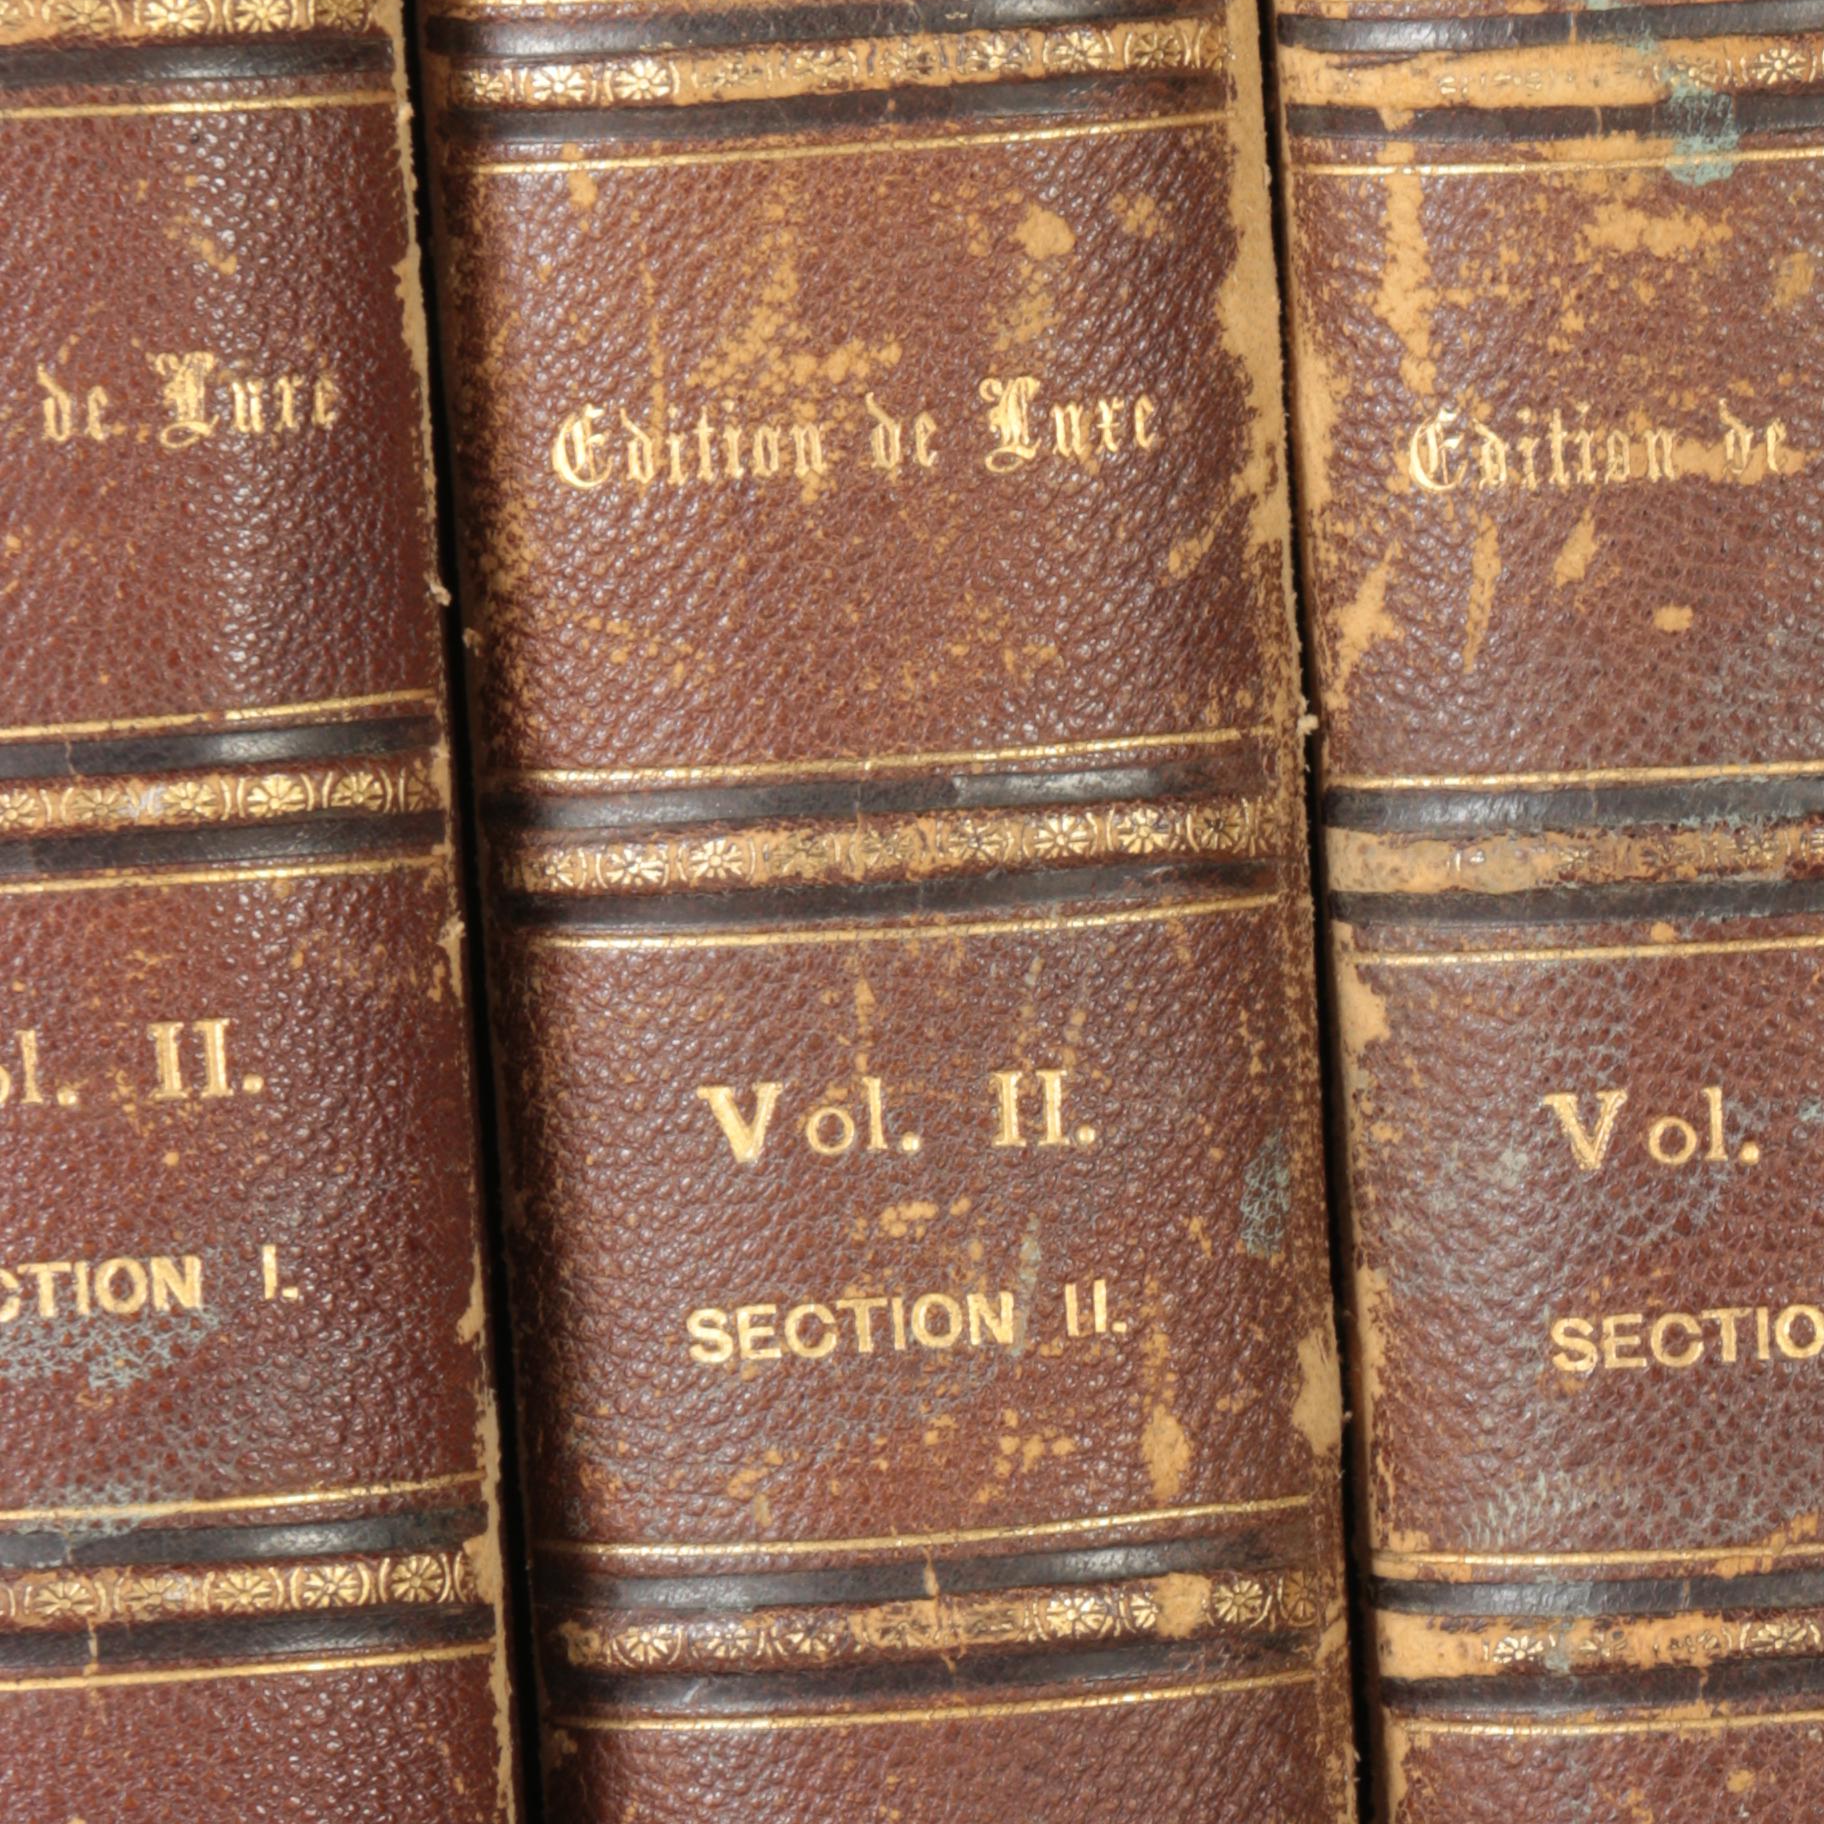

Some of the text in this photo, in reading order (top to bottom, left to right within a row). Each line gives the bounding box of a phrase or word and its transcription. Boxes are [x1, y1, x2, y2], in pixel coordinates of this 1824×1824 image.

[37, 351, 340, 448] de Luxe
[551, 376, 1167, 488] Edition de Luxe
[1409, 399, 1680, 492] Edition
[1718, 398, 1788, 474] de
[147, 1017, 264, 1100] II.
[697, 1070, 1097, 1163] Vol. II.
[1543, 1086, 1760, 1170] Vol.
[262, 1244, 299, 1300] I.
[687, 1279, 1128, 1364] SECTION II.
